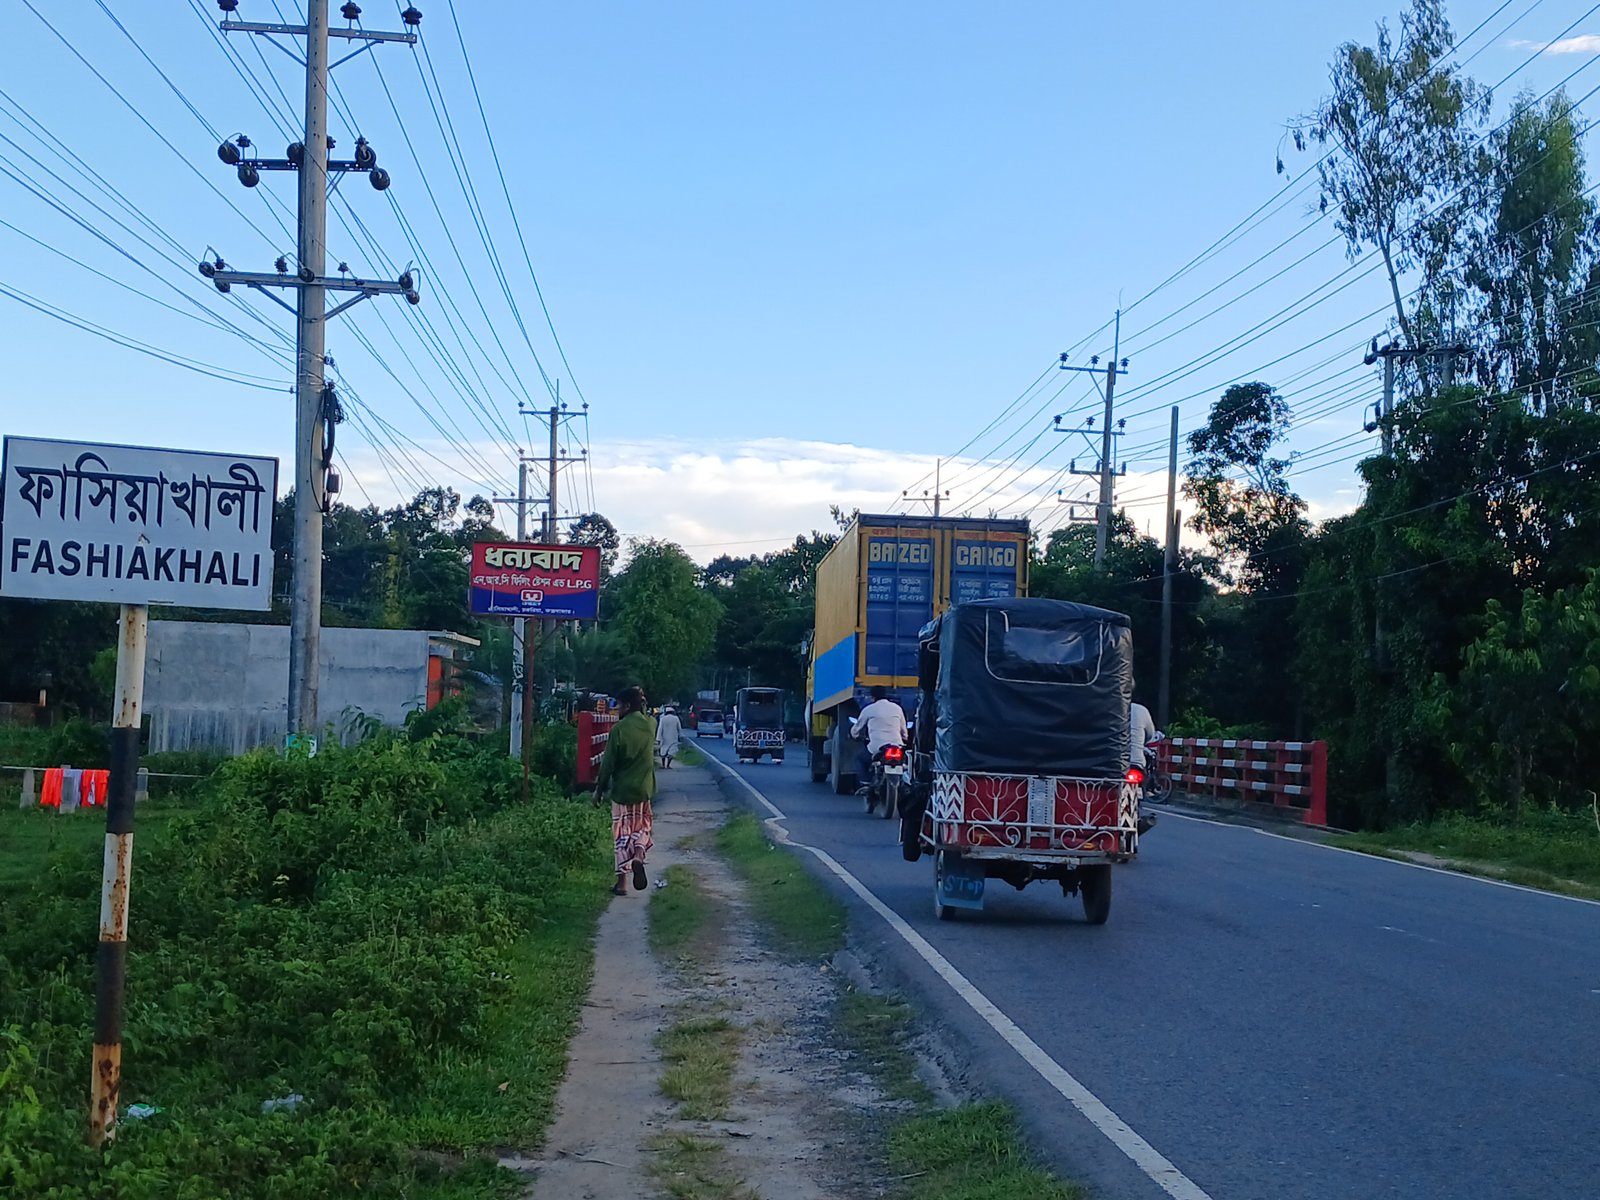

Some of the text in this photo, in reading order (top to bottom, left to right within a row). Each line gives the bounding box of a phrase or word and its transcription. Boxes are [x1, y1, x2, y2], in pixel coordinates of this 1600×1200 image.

[14, 452, 266, 534] ফাসিয়াখালী
[10, 537, 261, 588] FASHIAKHALI
[485, 547, 583, 571] ধন্যবাদ
[956, 545, 1016, 567] CARGO
